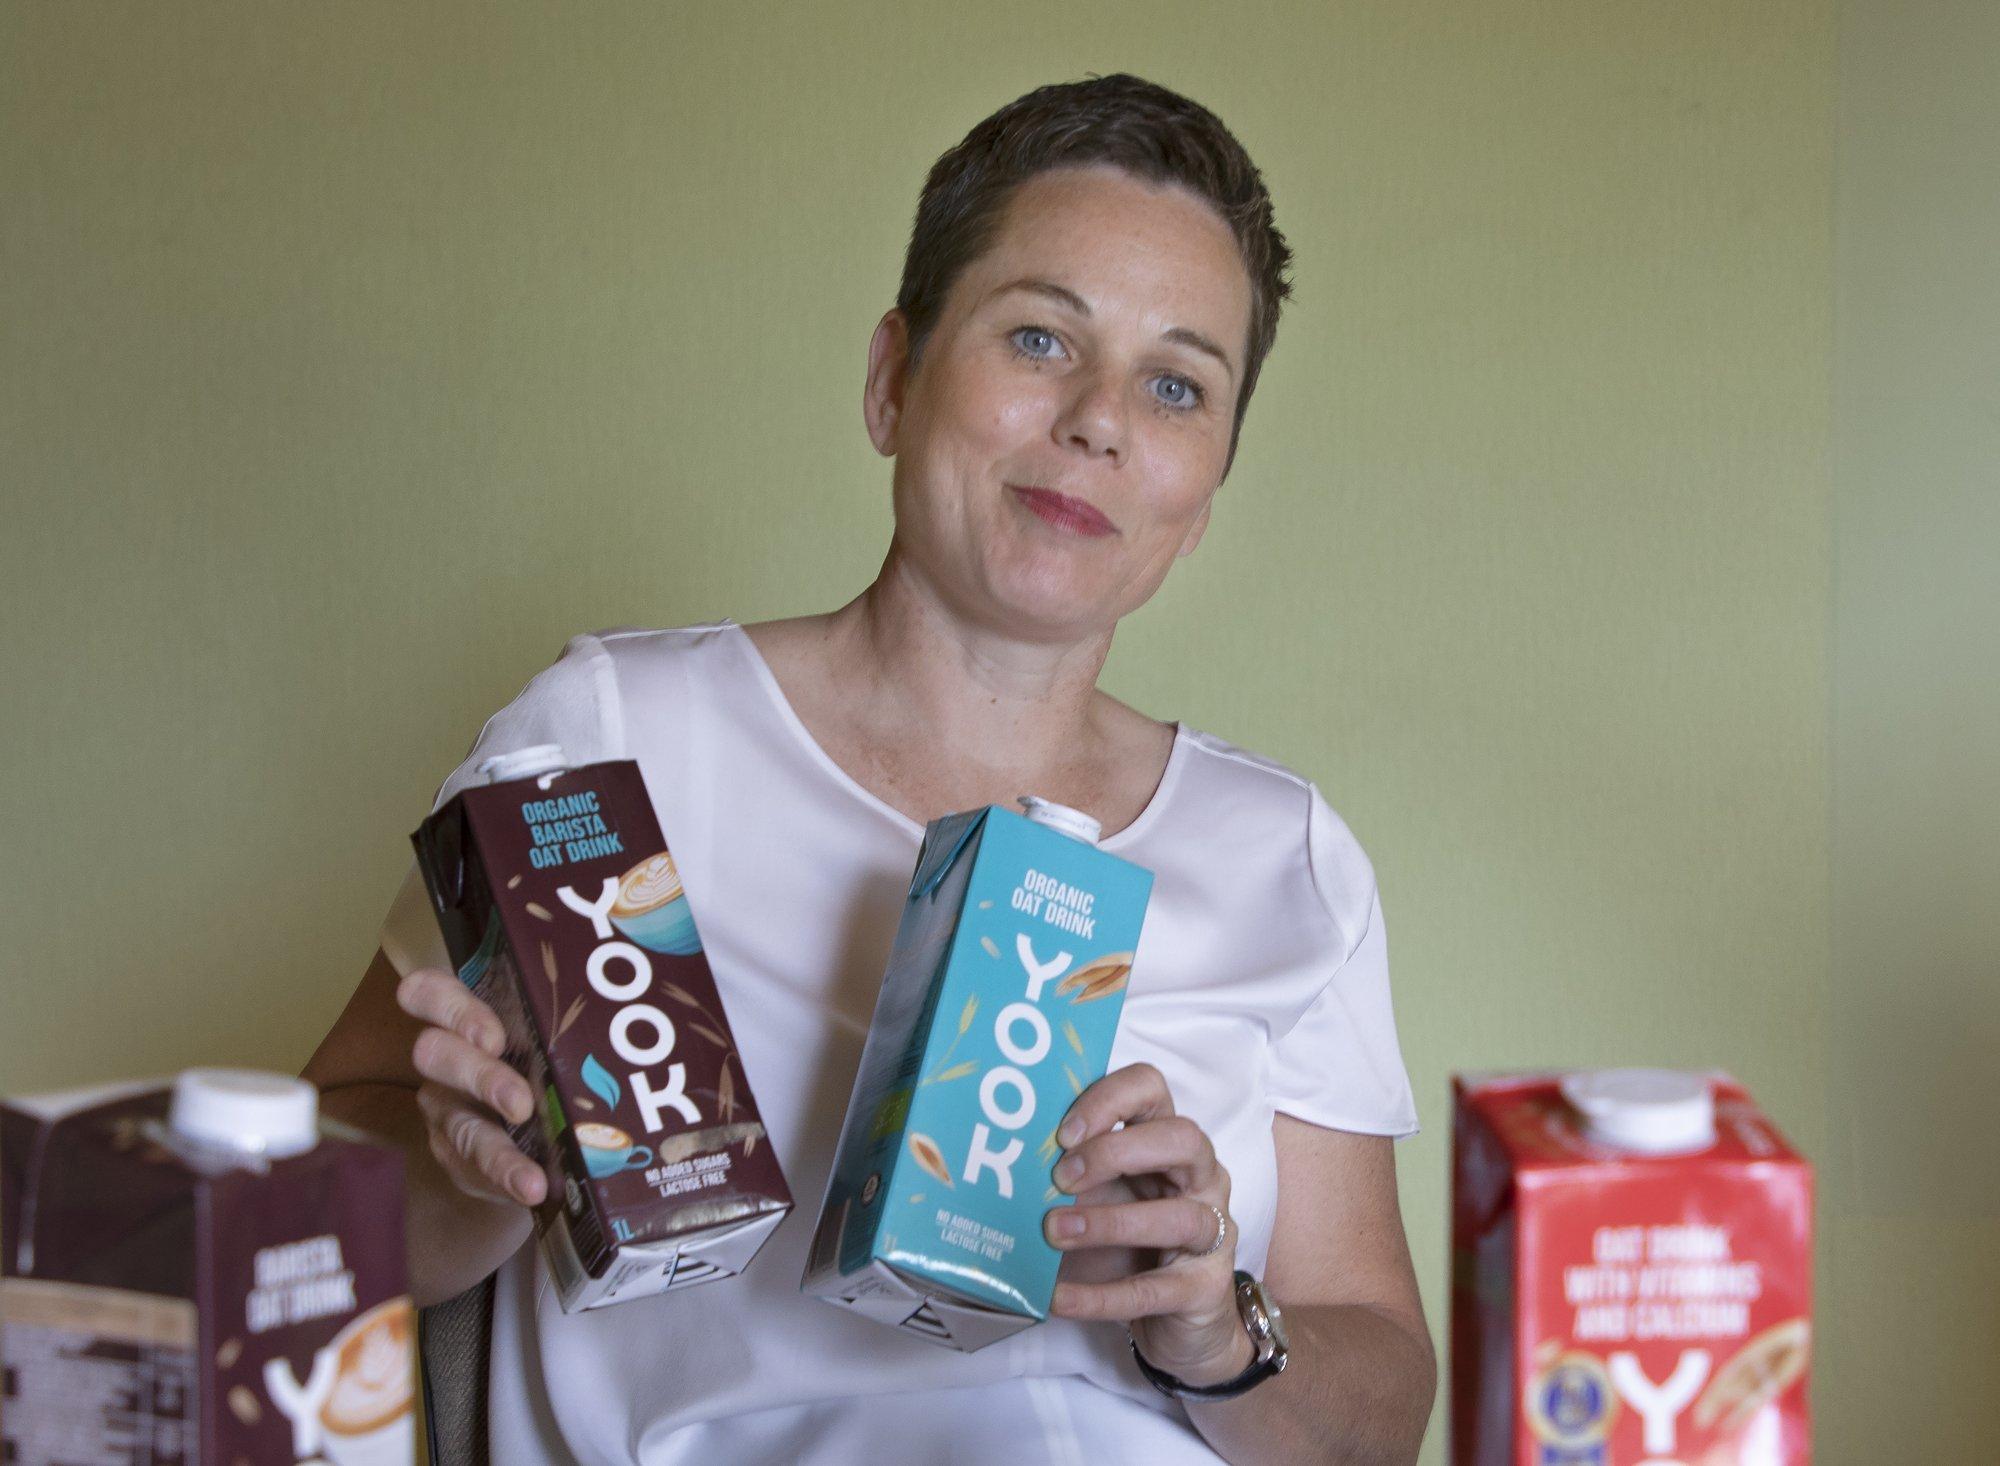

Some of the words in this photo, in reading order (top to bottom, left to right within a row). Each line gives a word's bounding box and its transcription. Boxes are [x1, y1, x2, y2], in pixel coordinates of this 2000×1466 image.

[521, 790, 600, 825] ORGANIC
[531, 813, 608, 846] BARISTA
[529, 844, 564, 870] OAT
[565, 831, 625, 863] DRINK
[1023, 868, 1096, 916] ORGANIC
[1011, 886, 1045, 918] OAT
[1043, 900, 1096, 941] DRINK
[556, 876, 702, 1134] YOOK
[963, 932, 1074, 1199] YOOK
[645, 1168, 660, 1184] NO
[661, 1160, 693, 1180] ADDED
[692, 1152, 731, 1173] SUGARS
[659, 1176, 702, 1198] LACTOSE
[702, 1170, 727, 1188] FREE
[611, 1217, 635, 1241] 1L
[935, 1208, 951, 1225] NO
[951, 1214, 980, 1236] ADDED
[981, 1224, 1015, 1251] SUGARS
[940, 1228, 979, 1253] LACTOSE
[980, 1242, 1003, 1262] FREE
